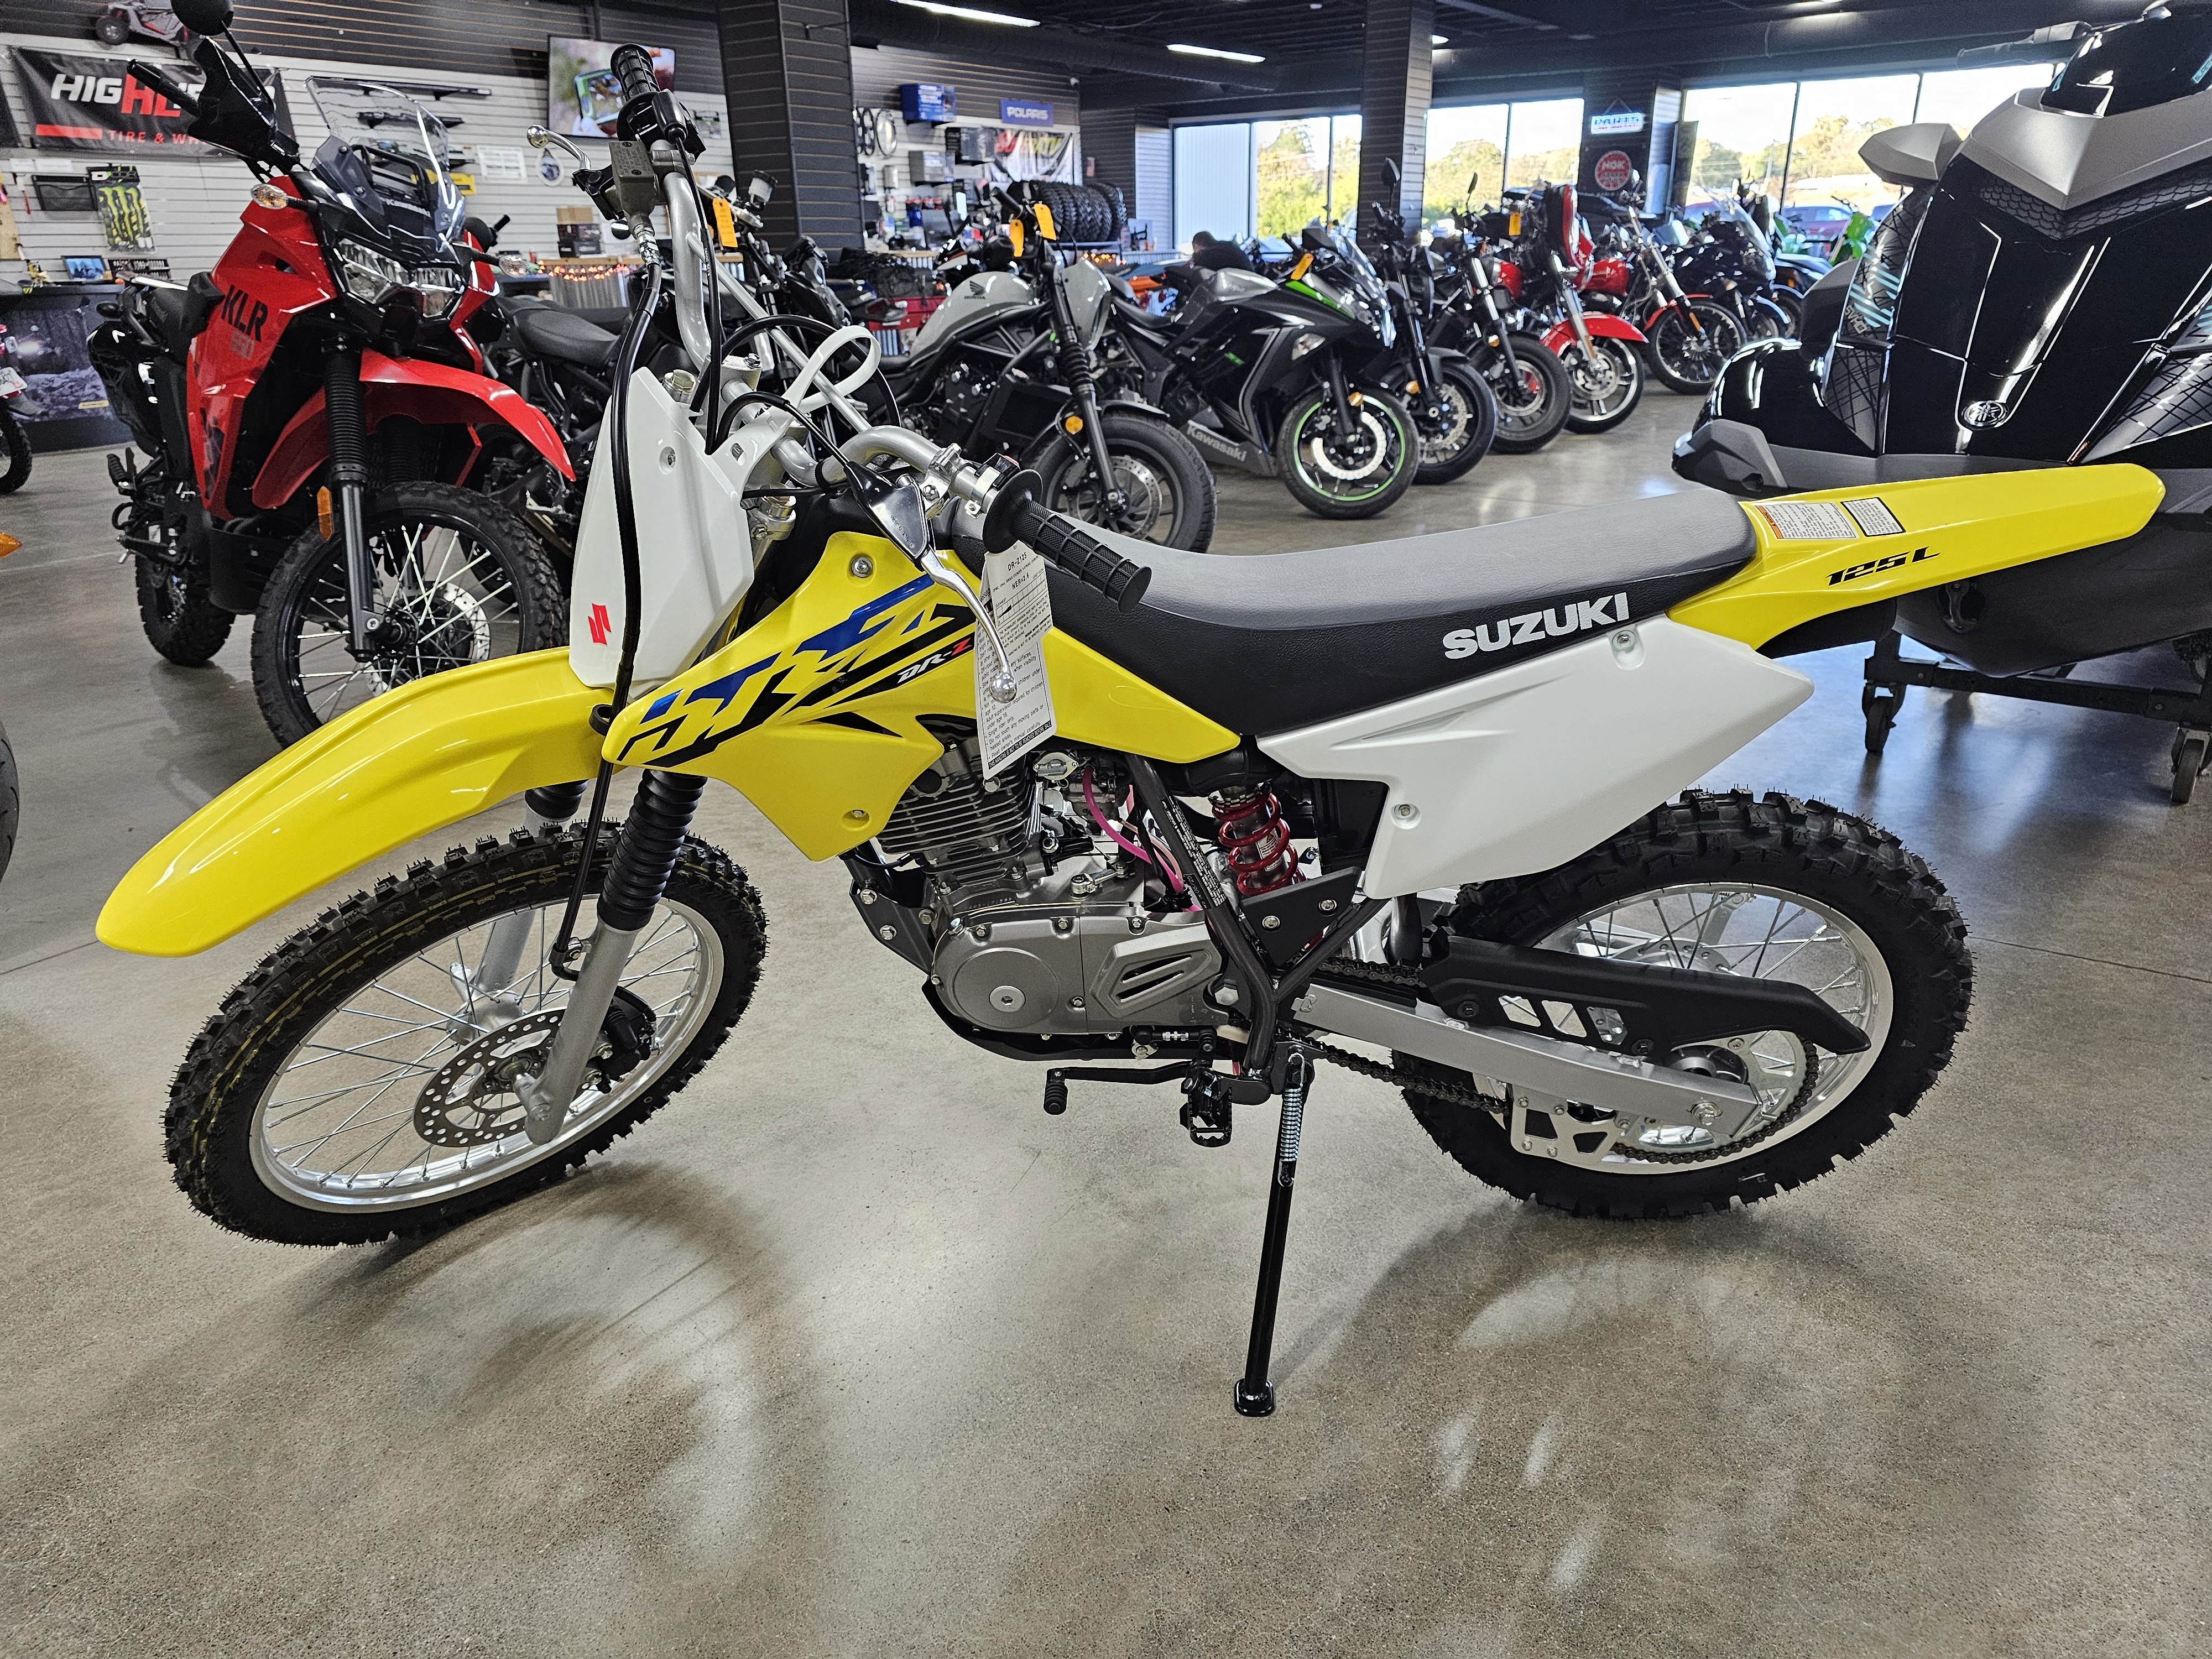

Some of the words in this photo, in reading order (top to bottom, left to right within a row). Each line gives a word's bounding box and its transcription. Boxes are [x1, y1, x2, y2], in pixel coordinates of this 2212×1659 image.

[1007, 106, 1048, 121] POLARIS
[110, 131, 146, 144] TIRE
[154, 132, 164, 144] &
[221, 285, 268, 343] KLR
[1187, 425, 1247, 462] Kawasaki
[1008, 552, 1027, 571] DR-Z125
[1012, 572, 1029, 589] NER=2.6
[1442, 592, 1629, 659] SUZUKI
[897, 637, 973, 684] DR-Z
[1018, 675, 1031, 685] children
[1032, 668, 1040, 676] under
[994, 703, 1011, 717] supervision
[1013, 692, 1025, 705] required
[1031, 681, 1044, 692] children
[987, 721, 995, 729] under
[1001, 727, 1010, 735] touch
[1018, 714, 1029, 724] moving
[1030, 708, 1039, 716] parts
[988, 728, 997, 737] Single
[1001, 740, 1013, 751] owner's
[1014, 731, 1025, 741] manual
[1026, 722, 1041, 733] carefully.
[1023, 733, 1034, 744] REMOVED
[1035, 727, 1045, 736] BEFORE
[990, 740, 1001, 751] heated
